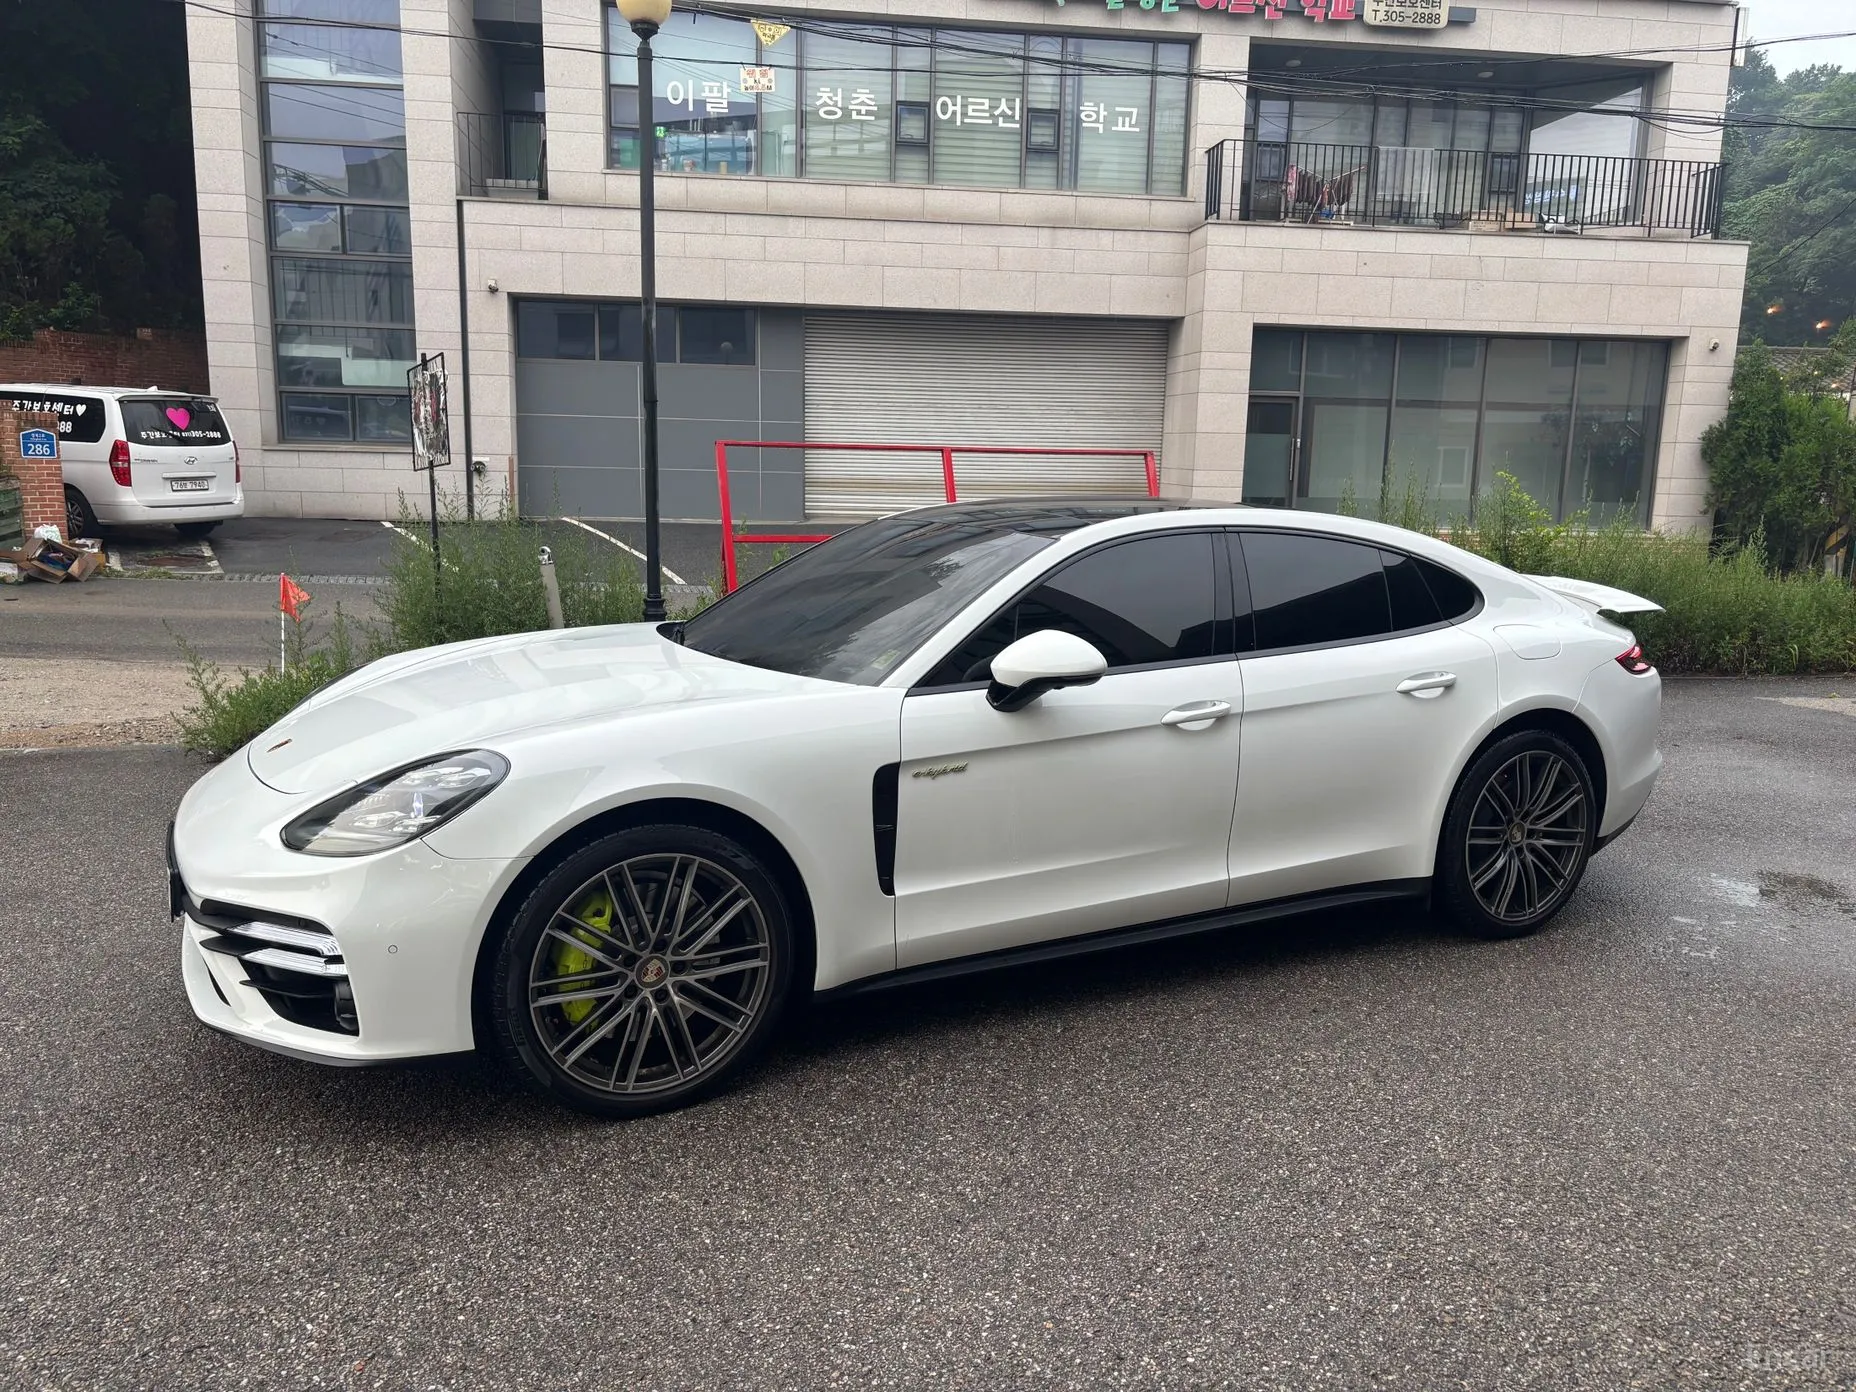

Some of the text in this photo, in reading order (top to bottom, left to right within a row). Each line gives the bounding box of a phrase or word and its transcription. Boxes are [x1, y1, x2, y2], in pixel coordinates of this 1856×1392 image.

[1372, 9, 1441, 25] T.305-2888
[666, 79, 1140, 134] 이팔 청춘 어르신 학교
[57, 420, 73, 433] 88
[28, 443, 50, 455] 286
